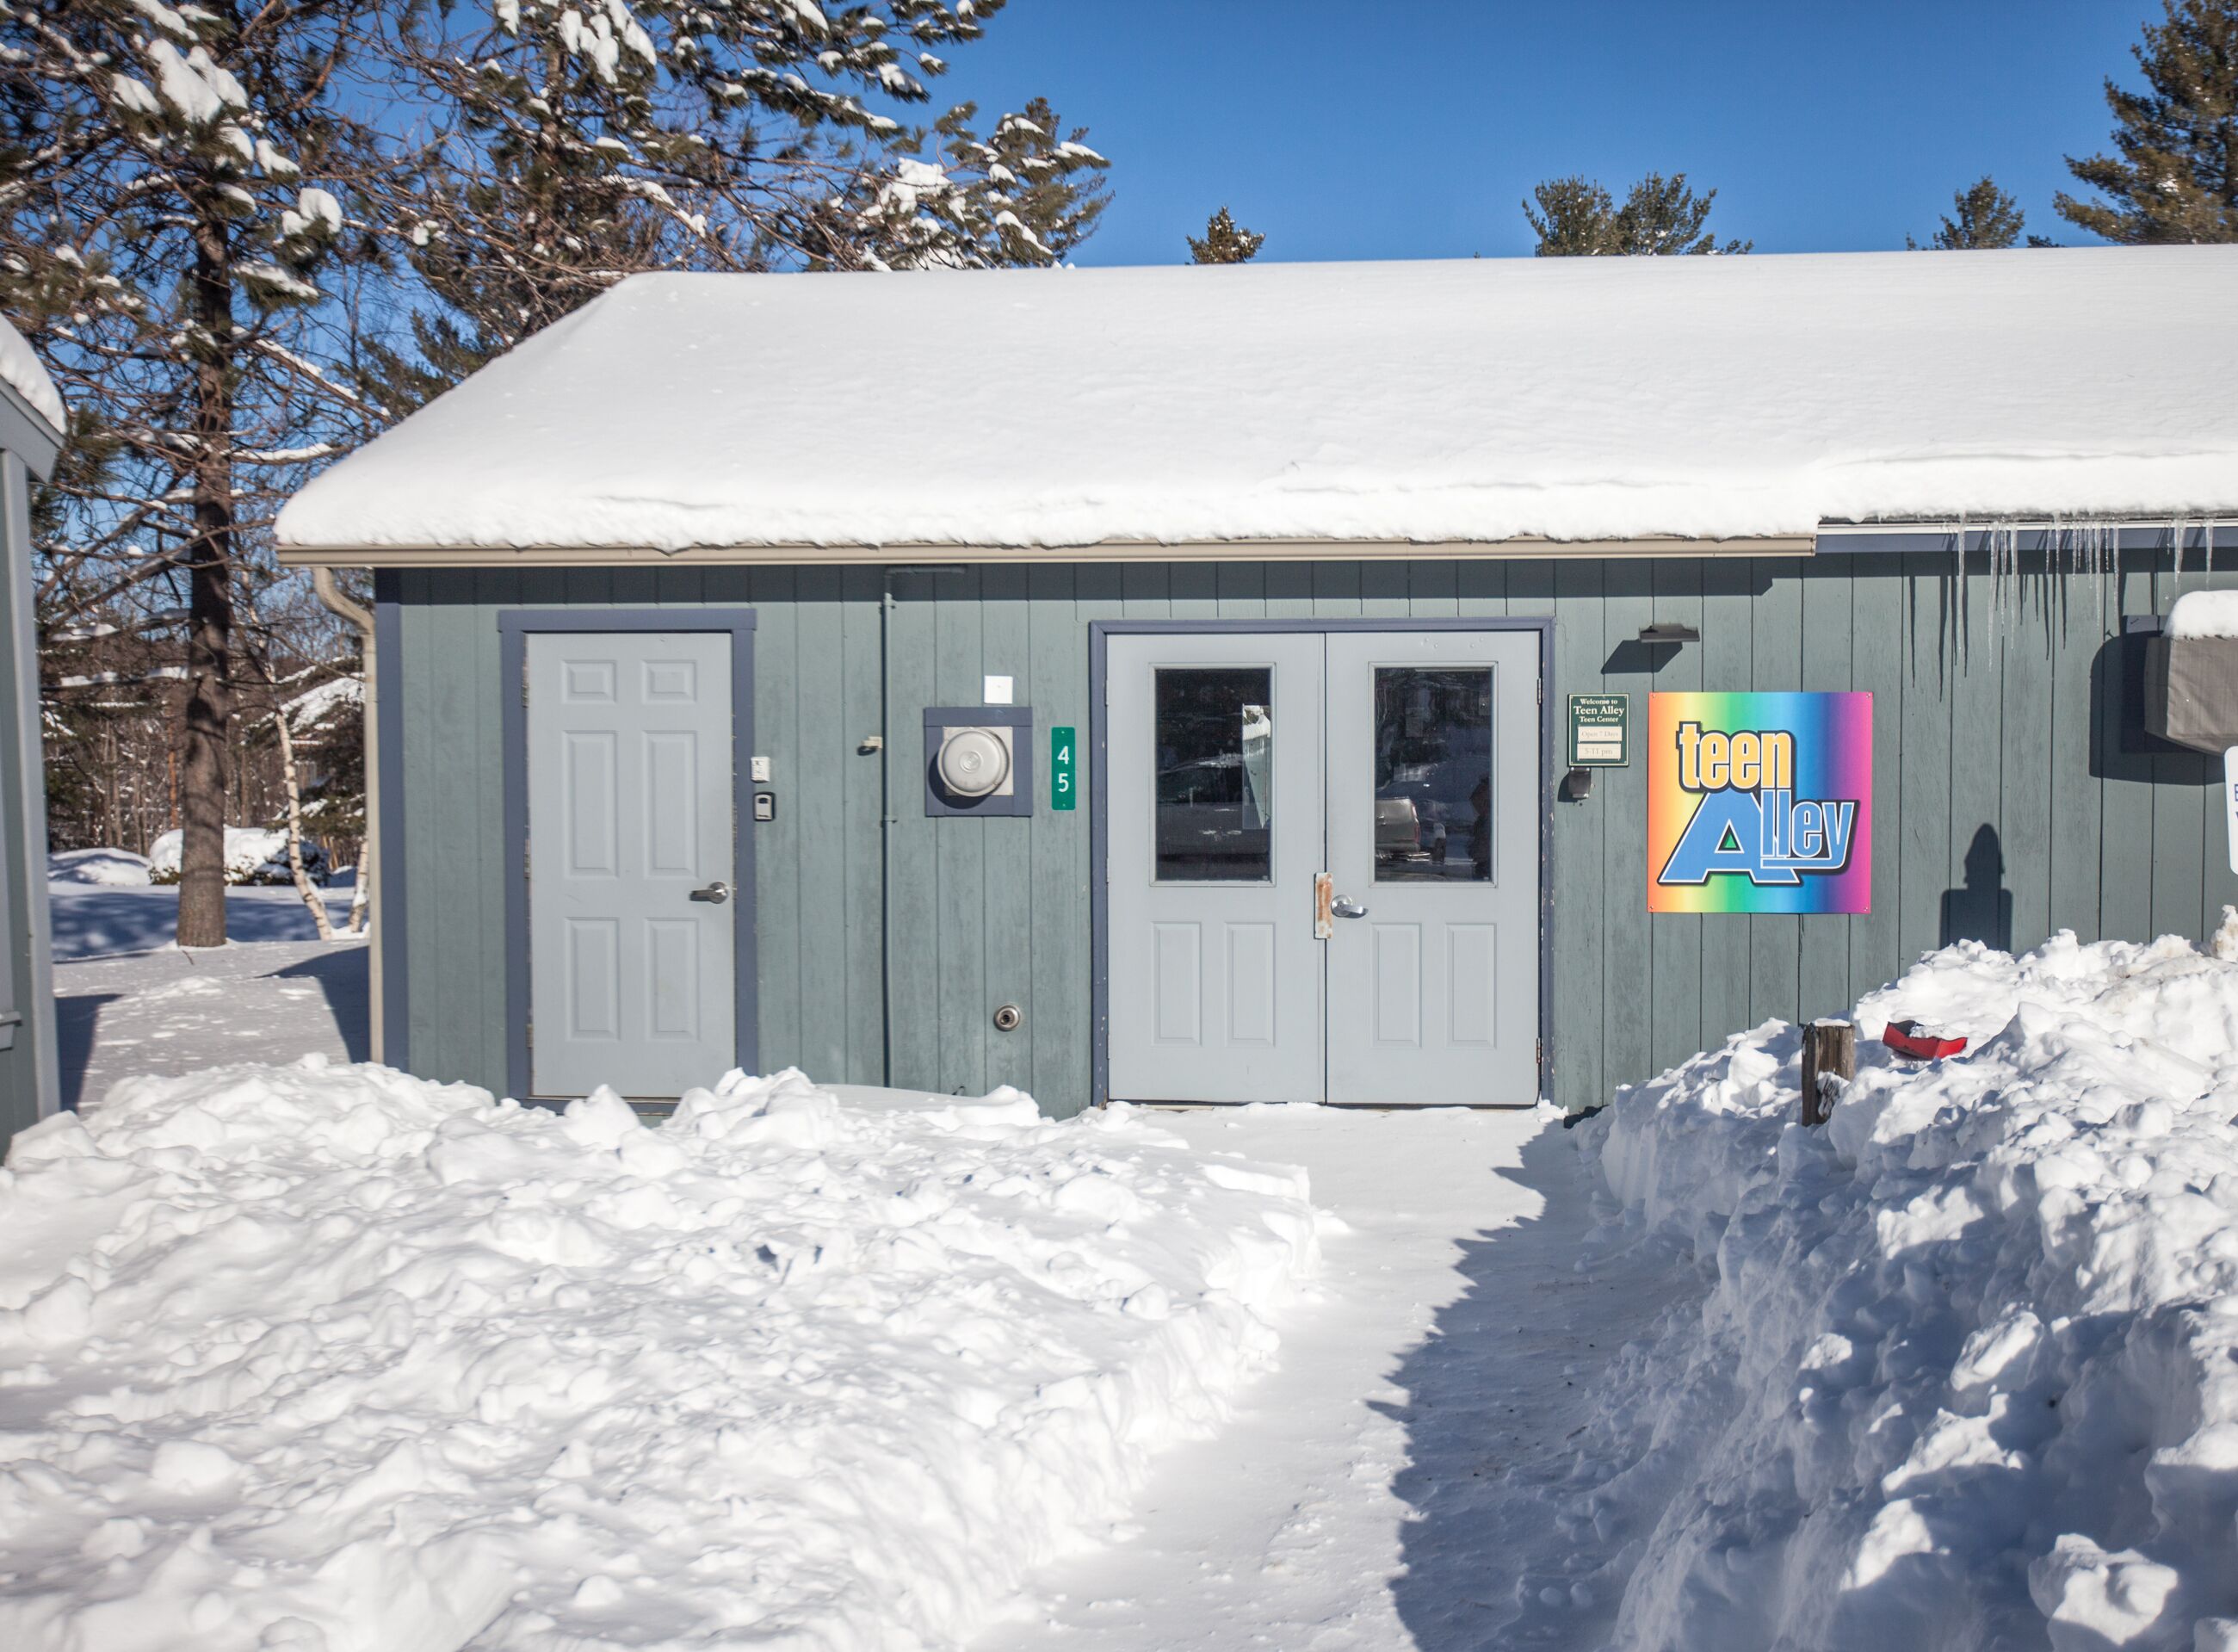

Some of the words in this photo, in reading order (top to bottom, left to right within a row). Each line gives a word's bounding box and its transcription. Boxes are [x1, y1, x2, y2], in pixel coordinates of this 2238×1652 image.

[1573, 706, 1598, 715] Teen
[1599, 706, 1625, 716] Alley
[1676, 721, 1796, 793] teen
[1657, 788, 1859, 886] Alley
